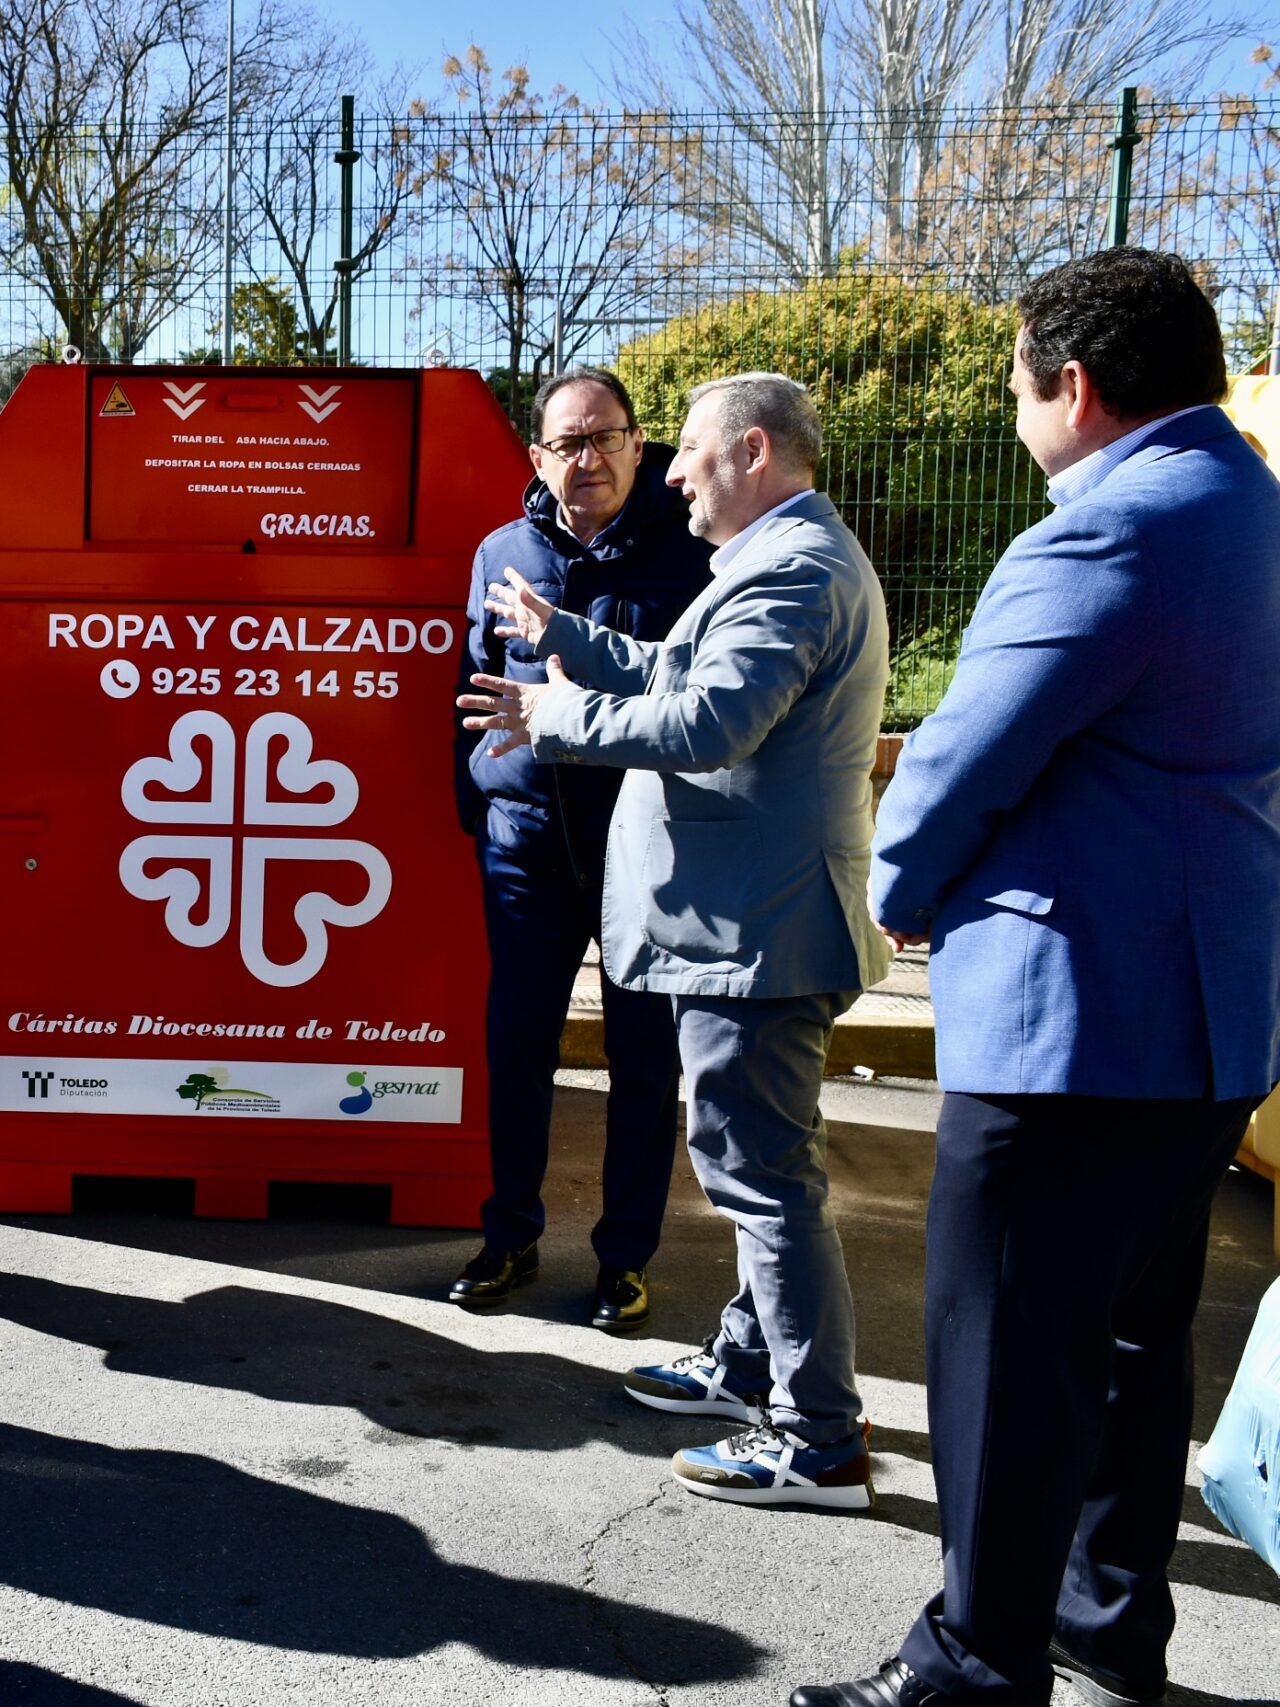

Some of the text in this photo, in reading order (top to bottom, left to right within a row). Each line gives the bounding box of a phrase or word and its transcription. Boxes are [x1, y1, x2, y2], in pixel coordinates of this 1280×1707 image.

[171, 434, 330, 446] TIRAR DEL ASA HACIA ABAJO.
[144, 458, 361, 471] DEPOSITAR LA ROPA EN BOLSAS CERRADAS
[187, 484, 306, 495] CERRAR LA TRAMPILLA.
[260, 513, 376, 539] GRACIAS.
[48, 613, 454, 654] ROPA Y CALZADO
[151, 667, 399, 699] 925 23 14 55
[8, 1011, 446, 1044] Cáritas Diocesana de Toledo
[59, 1078, 108, 1088] TOLEDO
[372, 1081, 440, 1099] gesmat
[60, 1089, 108, 1097] Diputación
